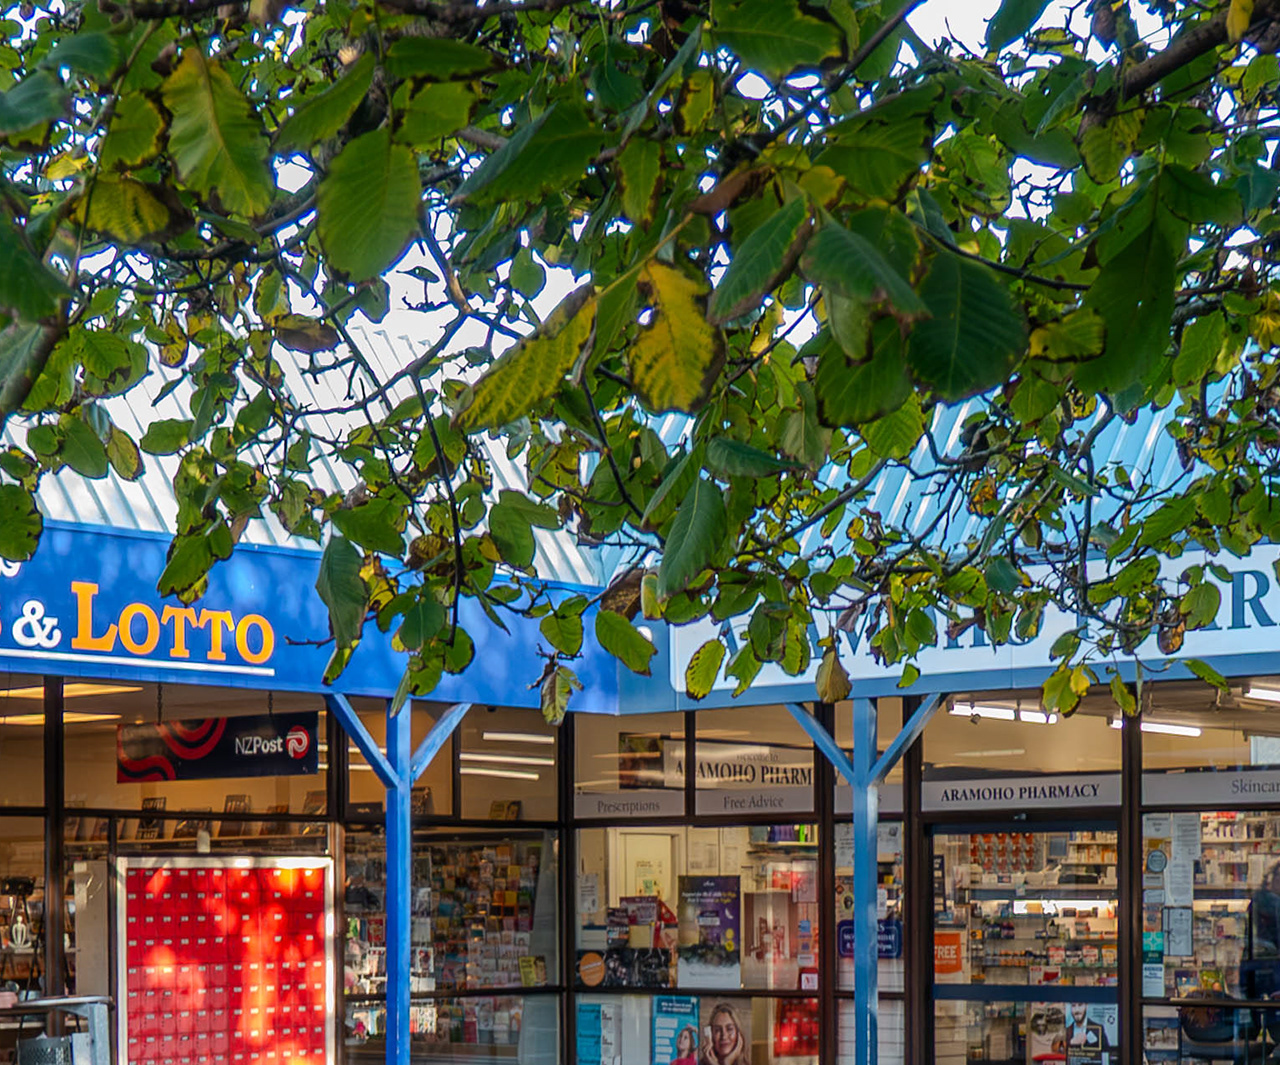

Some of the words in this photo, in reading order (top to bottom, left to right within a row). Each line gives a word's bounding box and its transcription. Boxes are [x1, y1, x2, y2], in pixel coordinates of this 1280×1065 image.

[12, 600, 62, 648] &
[71, 581, 275, 665] LOTTO
[235, 735, 283, 755] NZPost
[676, 761, 754, 783] AAMOHO
[723, 796, 745, 809] Free
[748, 795, 784, 809] Advice
[941, 787, 1014, 802] ARAMOHO
[1019, 783, 1100, 799] PHARMACY
[597, 799, 660, 815] Prescriptions
